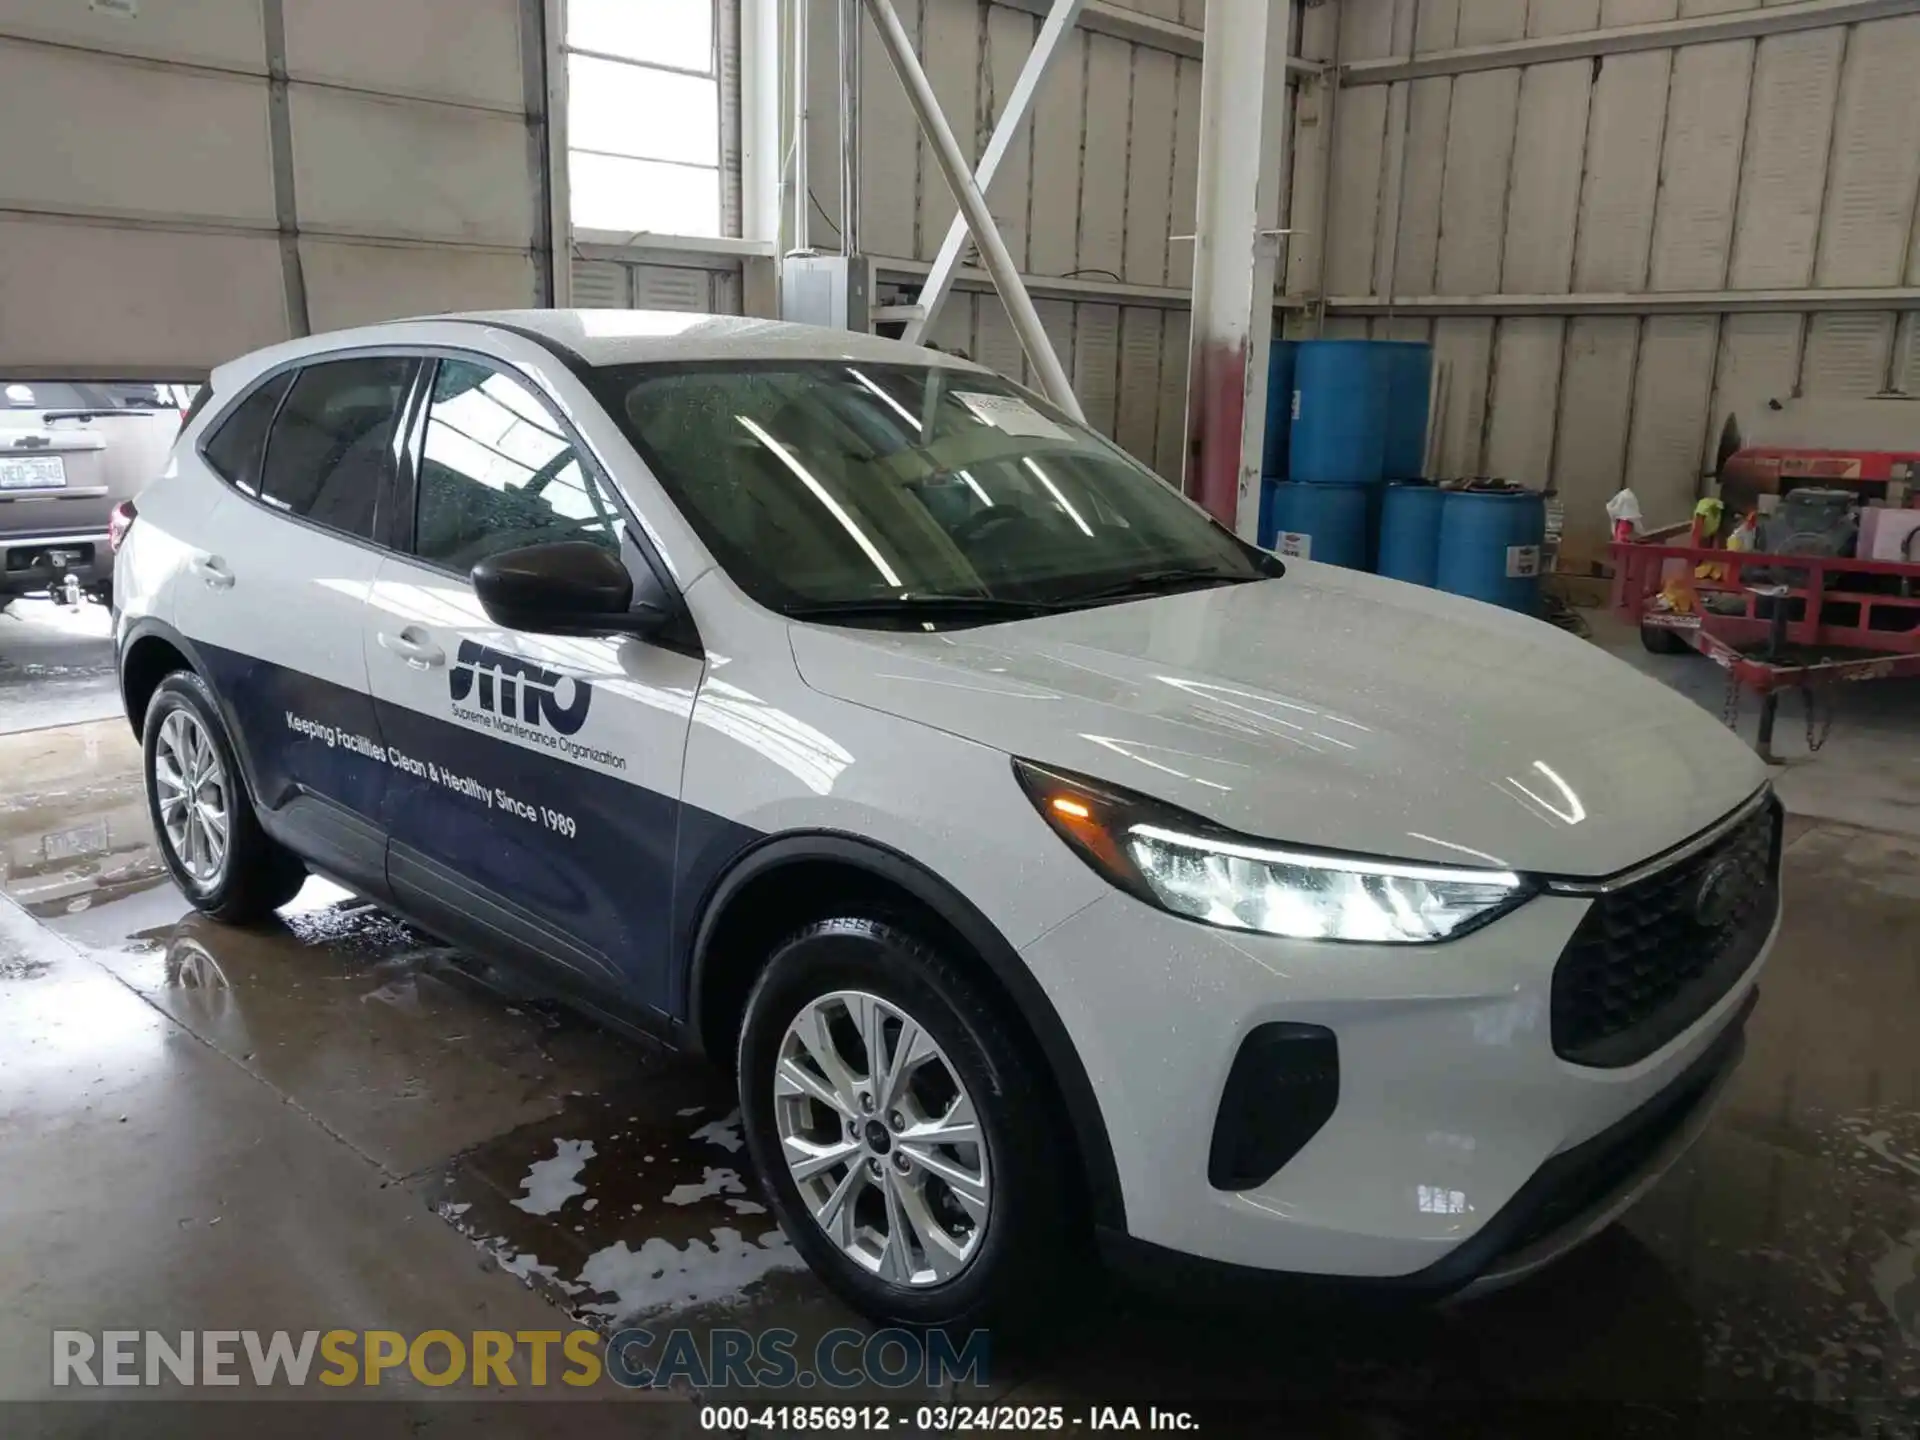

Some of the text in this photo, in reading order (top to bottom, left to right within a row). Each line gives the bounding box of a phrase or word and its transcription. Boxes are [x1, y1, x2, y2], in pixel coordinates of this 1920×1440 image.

[285, 710, 576, 838] Keeping Facilities Clean & Healthy Since 1989
[451, 703, 627, 770] Supreme Maintenance Organization
